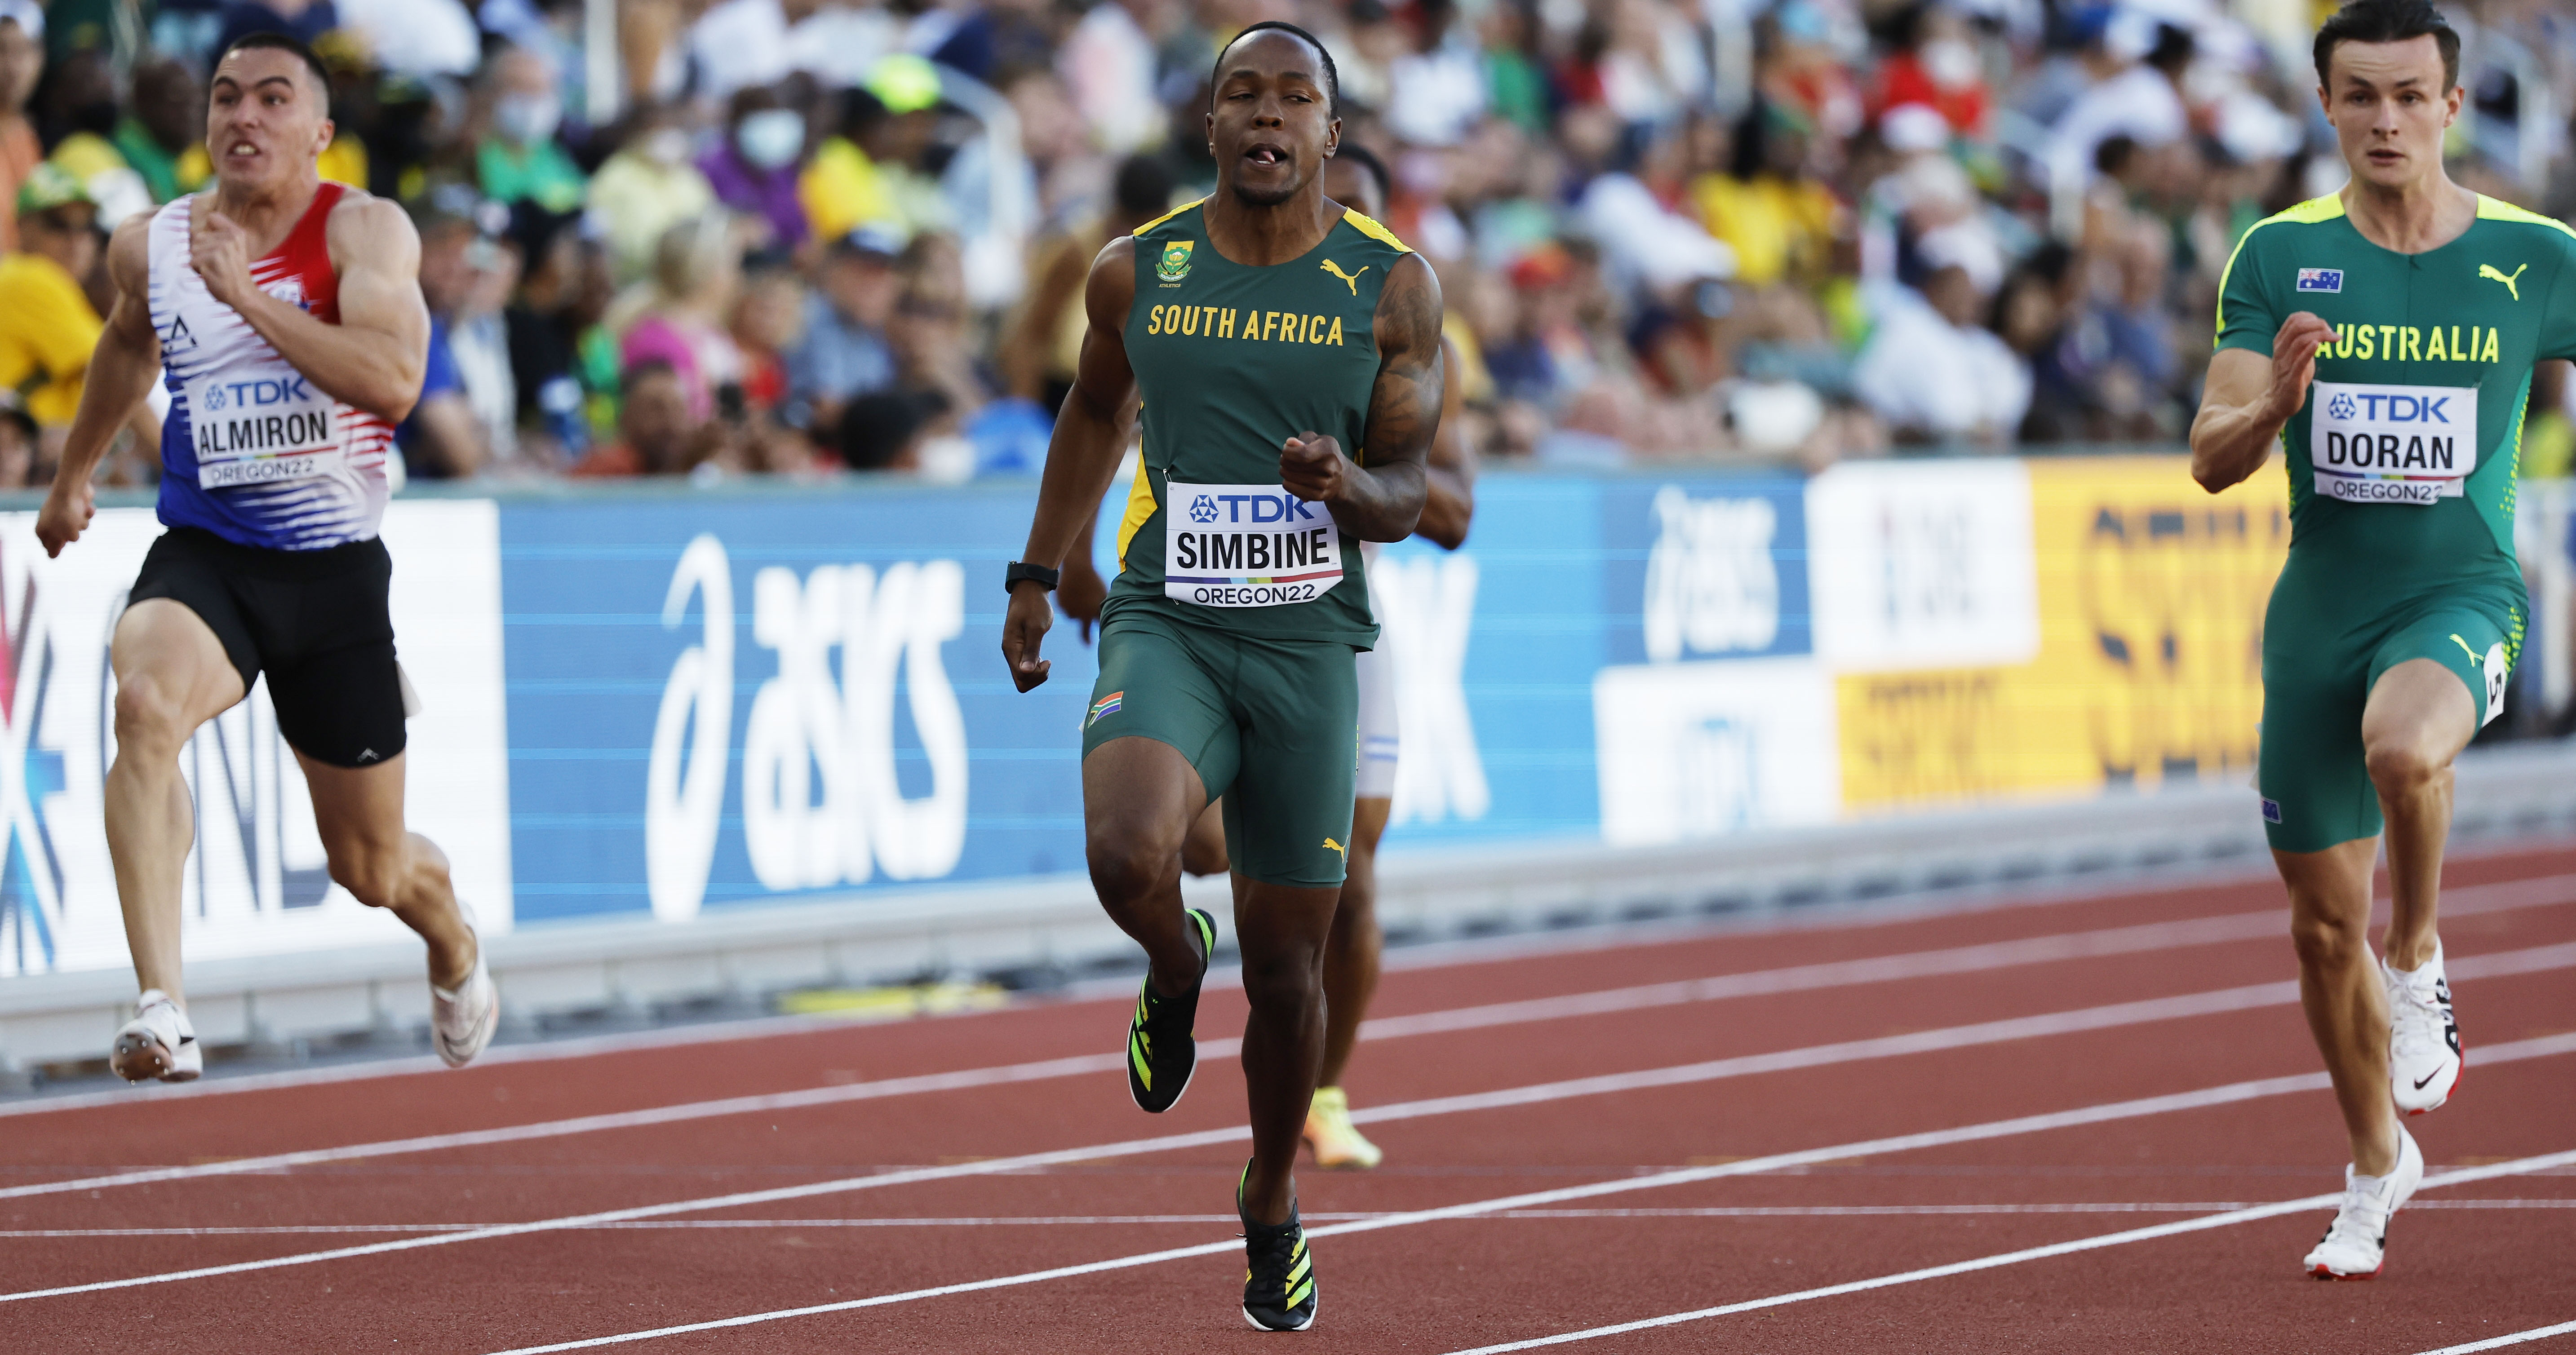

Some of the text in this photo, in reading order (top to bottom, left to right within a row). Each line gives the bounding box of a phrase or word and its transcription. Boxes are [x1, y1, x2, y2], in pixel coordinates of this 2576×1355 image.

[1148, 304, 1343, 346] SOUTH AFRICA
[227, 376, 310, 407] TDK
[2357, 394, 2451, 424] TDK
[200, 411, 327, 454] ALMIRON
[2327, 431, 2453, 469] DORAN
[210, 459, 313, 482] OREGON22
[1218, 494, 1315, 523] TDK
[1177, 527, 1330, 569] SIMBINE
[1194, 584, 1315, 604] OREGON22
